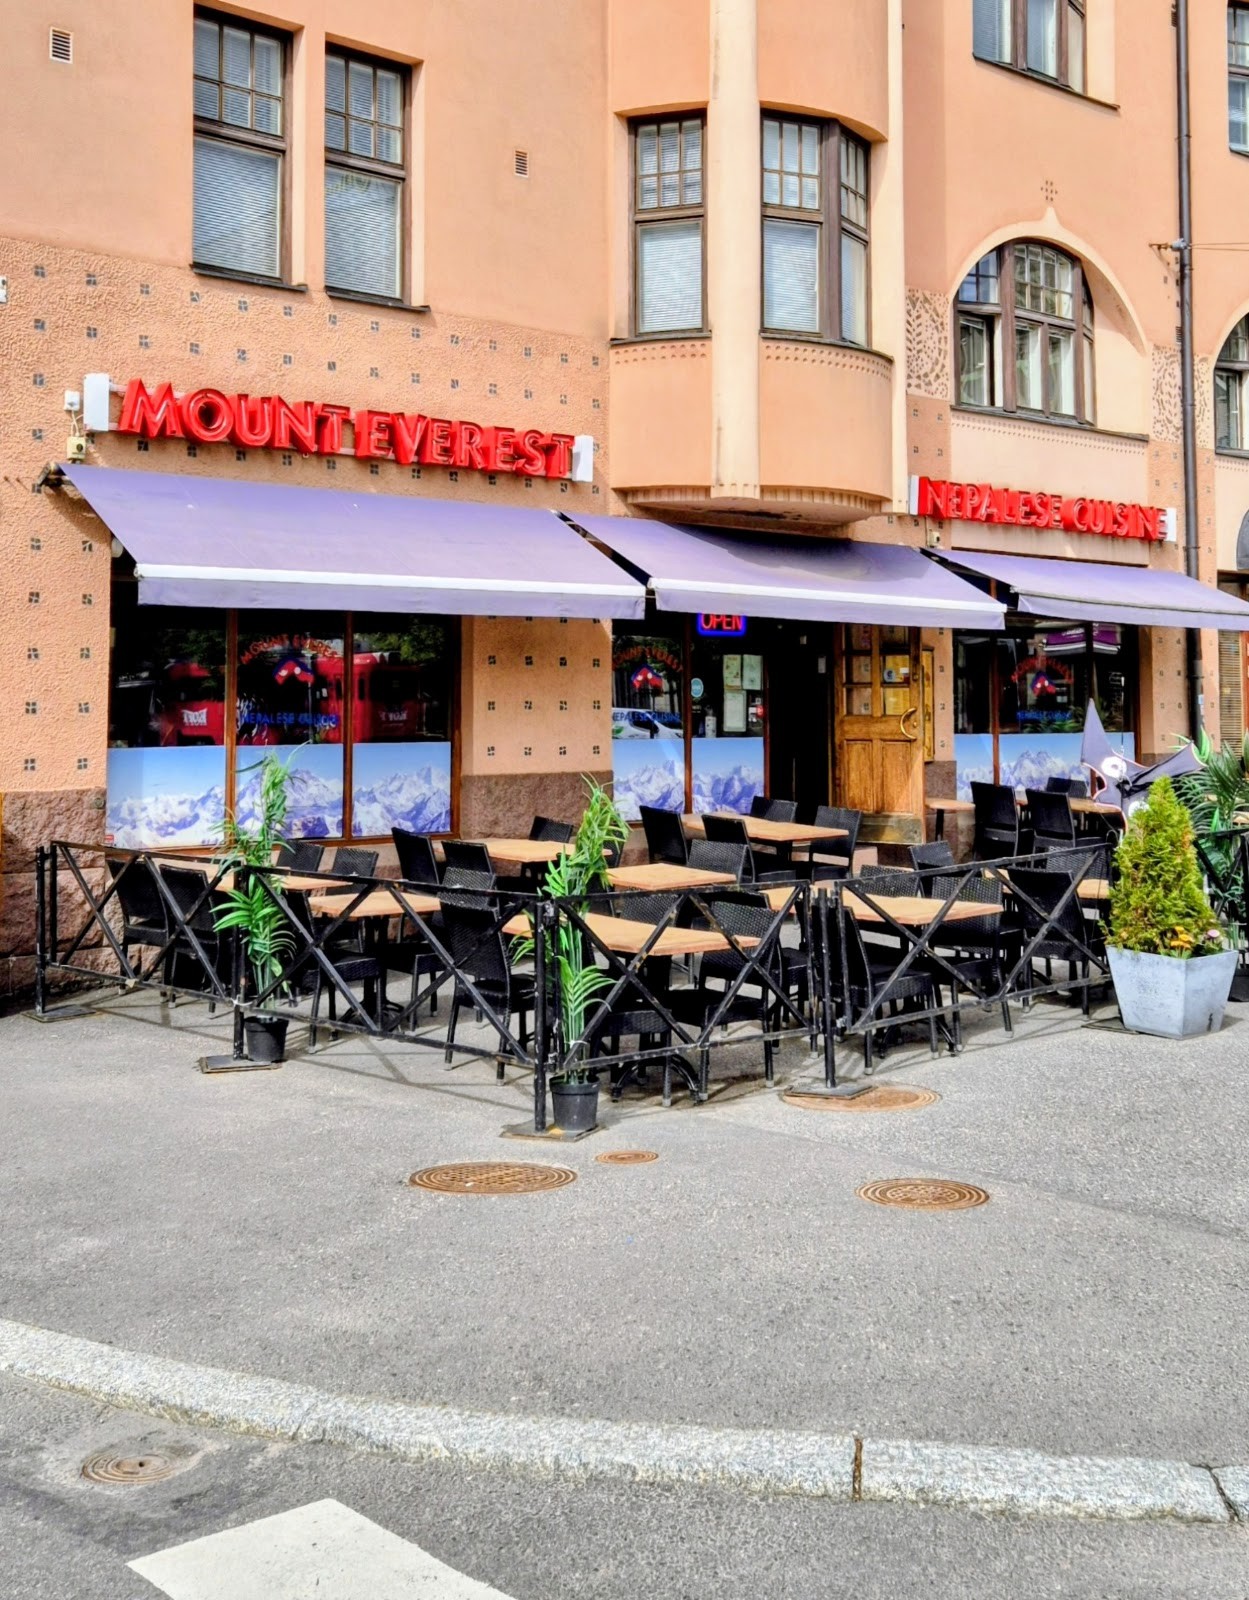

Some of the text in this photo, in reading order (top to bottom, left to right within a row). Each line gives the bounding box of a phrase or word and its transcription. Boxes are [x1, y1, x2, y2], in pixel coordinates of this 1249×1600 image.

[117, 378, 577, 478] MOUNT EVEREST
[919, 475, 1169, 542] NEPALESE CUISINE
[700, 612, 744, 631] OPEN
